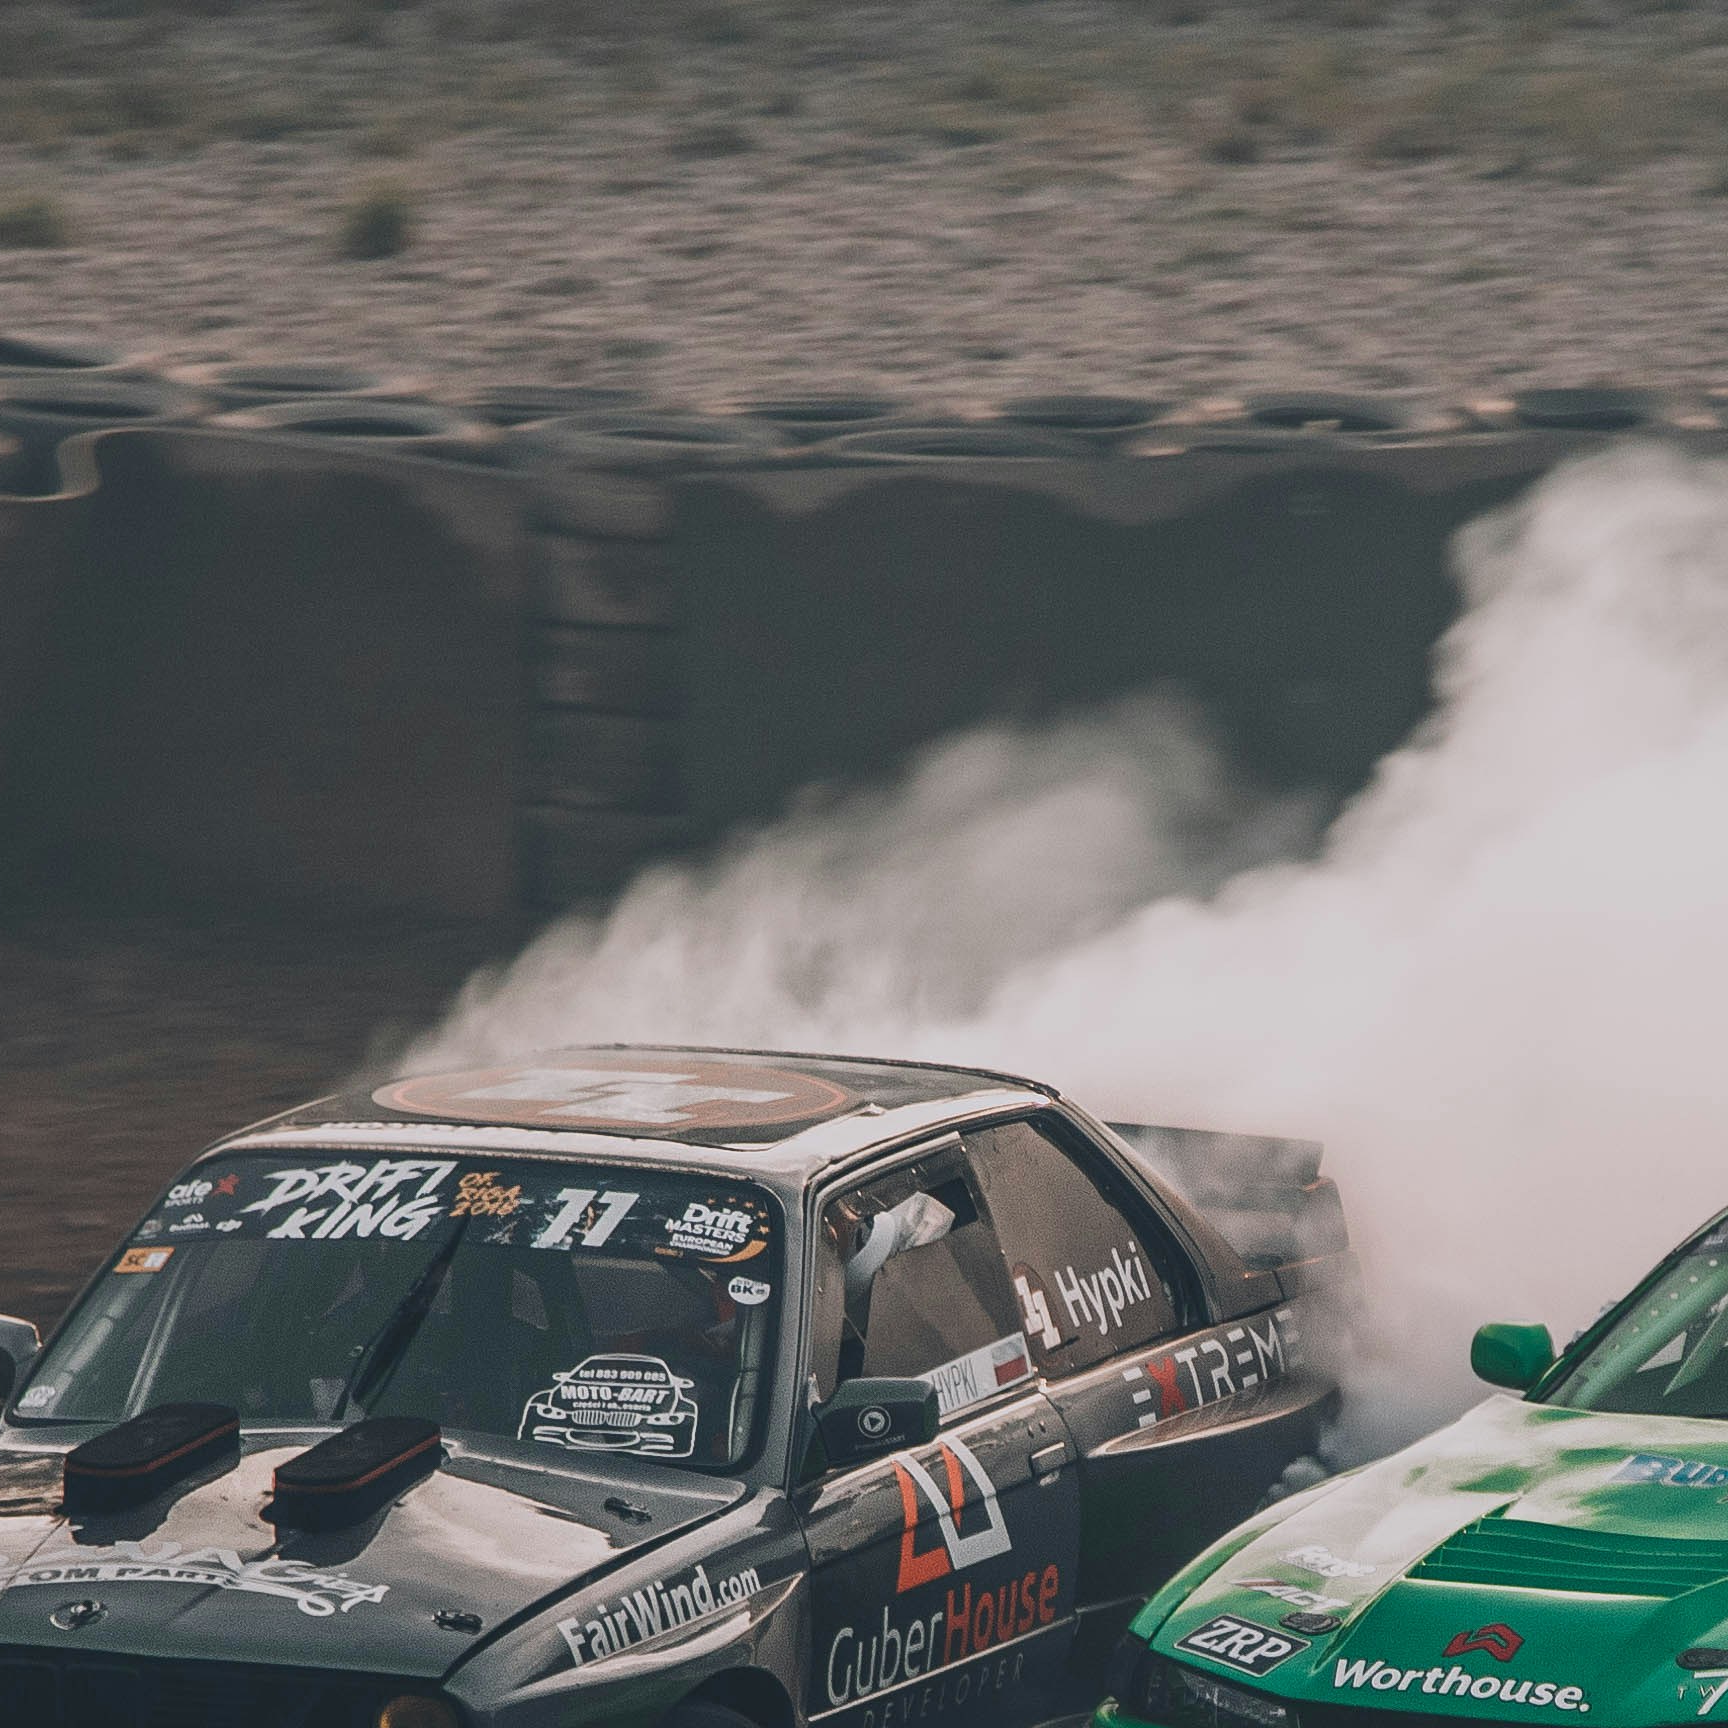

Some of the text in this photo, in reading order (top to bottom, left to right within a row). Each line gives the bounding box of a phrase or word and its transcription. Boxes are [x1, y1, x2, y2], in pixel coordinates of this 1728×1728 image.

[239, 1160, 459, 1214] DRIFT
[266, 1196, 444, 1241] KING
[533, 1188, 640, 1248] 11
[665, 1218, 746, 1244] MASTERS
[672, 1232, 734, 1251] EUROPEAN
[682, 1202, 755, 1233] Drift
[1014, 1275, 1063, 1350] 11
[1055, 1241, 1151, 1336] Hypki
[560, 1385, 670, 1405] MOTO-BART
[931, 1359, 978, 1412] HYPKI
[557, 1565, 761, 1667] FairWind.com
[1188, 1619, 1292, 1664] ZRP
[1334, 1659, 1590, 1712] Worthouse.
